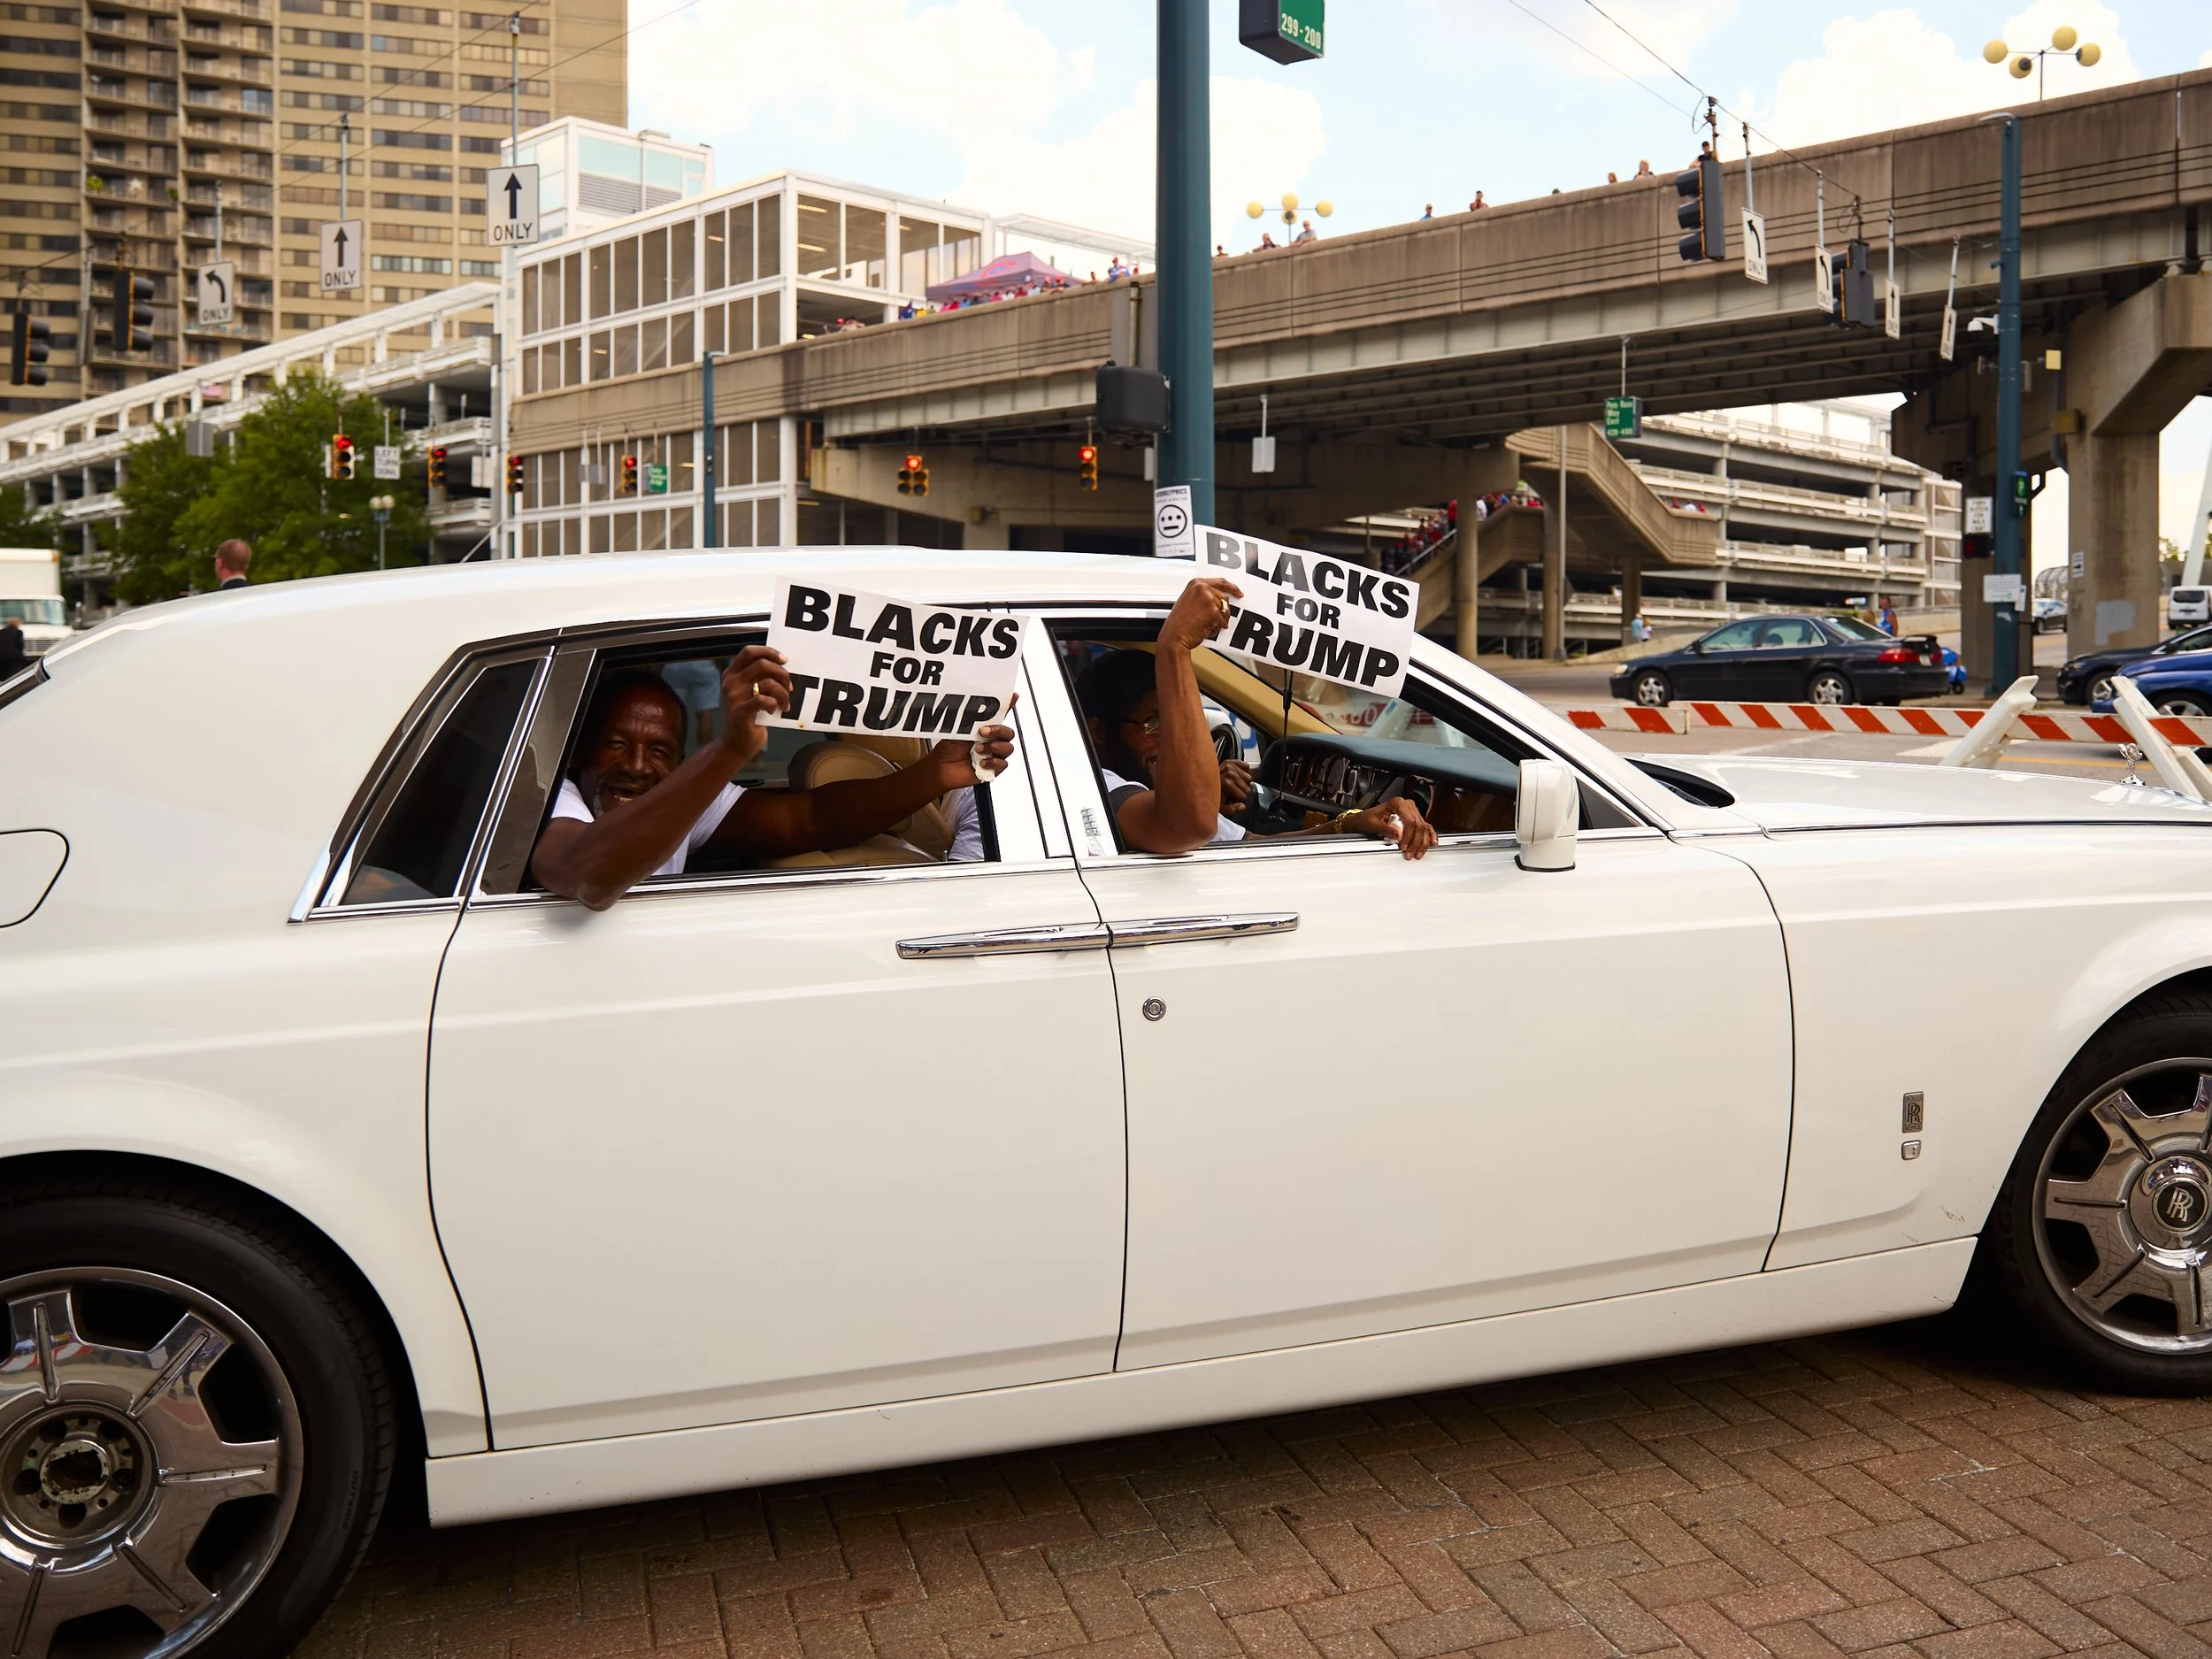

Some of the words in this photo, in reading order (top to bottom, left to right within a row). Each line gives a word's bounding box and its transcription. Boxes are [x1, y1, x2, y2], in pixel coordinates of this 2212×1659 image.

[494, 222, 533, 241] ONLY
[325, 271, 356, 288] ONLY
[1747, 258, 1764, 276] ONLY
[202, 308, 230, 322] ONLY
[1206, 531, 1409, 619] BLACKS
[784, 584, 1019, 659] BLACKS
[1276, 592, 1340, 630] FOR
[869, 651, 945, 686] FOR
[780, 672, 1001, 735] TRUMP
[2165, 1187, 2194, 1223] RR
